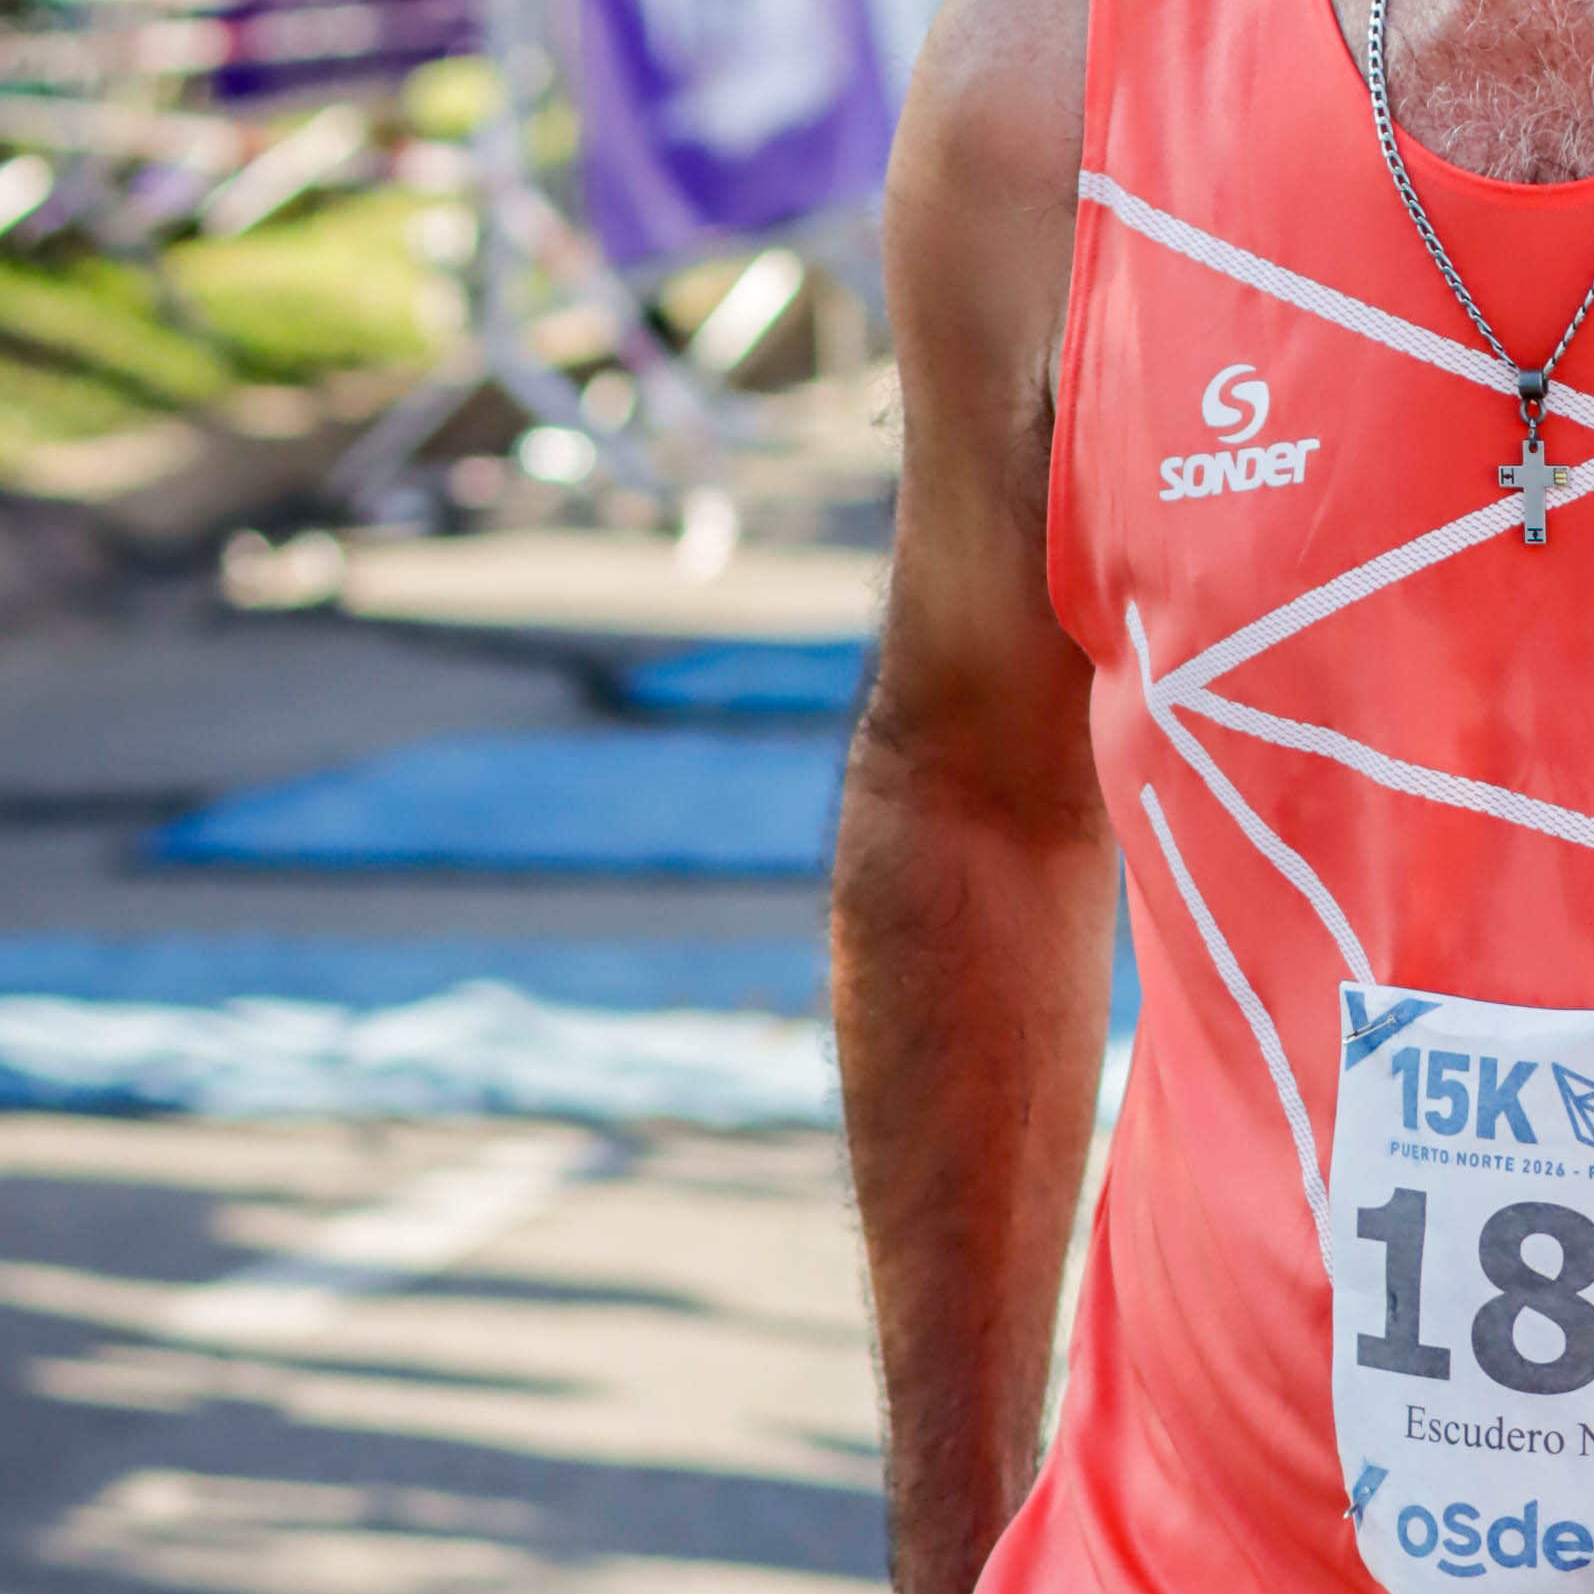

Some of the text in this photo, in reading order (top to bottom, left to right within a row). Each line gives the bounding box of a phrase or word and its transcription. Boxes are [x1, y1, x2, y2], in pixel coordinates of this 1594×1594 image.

[1390, 1045, 1540, 1145] 15K
[1390, 1141, 1449, 1165] PUERTO
[1456, 1151, 1515, 1173] NORTE
[1521, 1158, 1566, 1178] 2026
[1404, 1404, 1565, 1455] Escudero
[1396, 1499, 1594, 1573] osde
